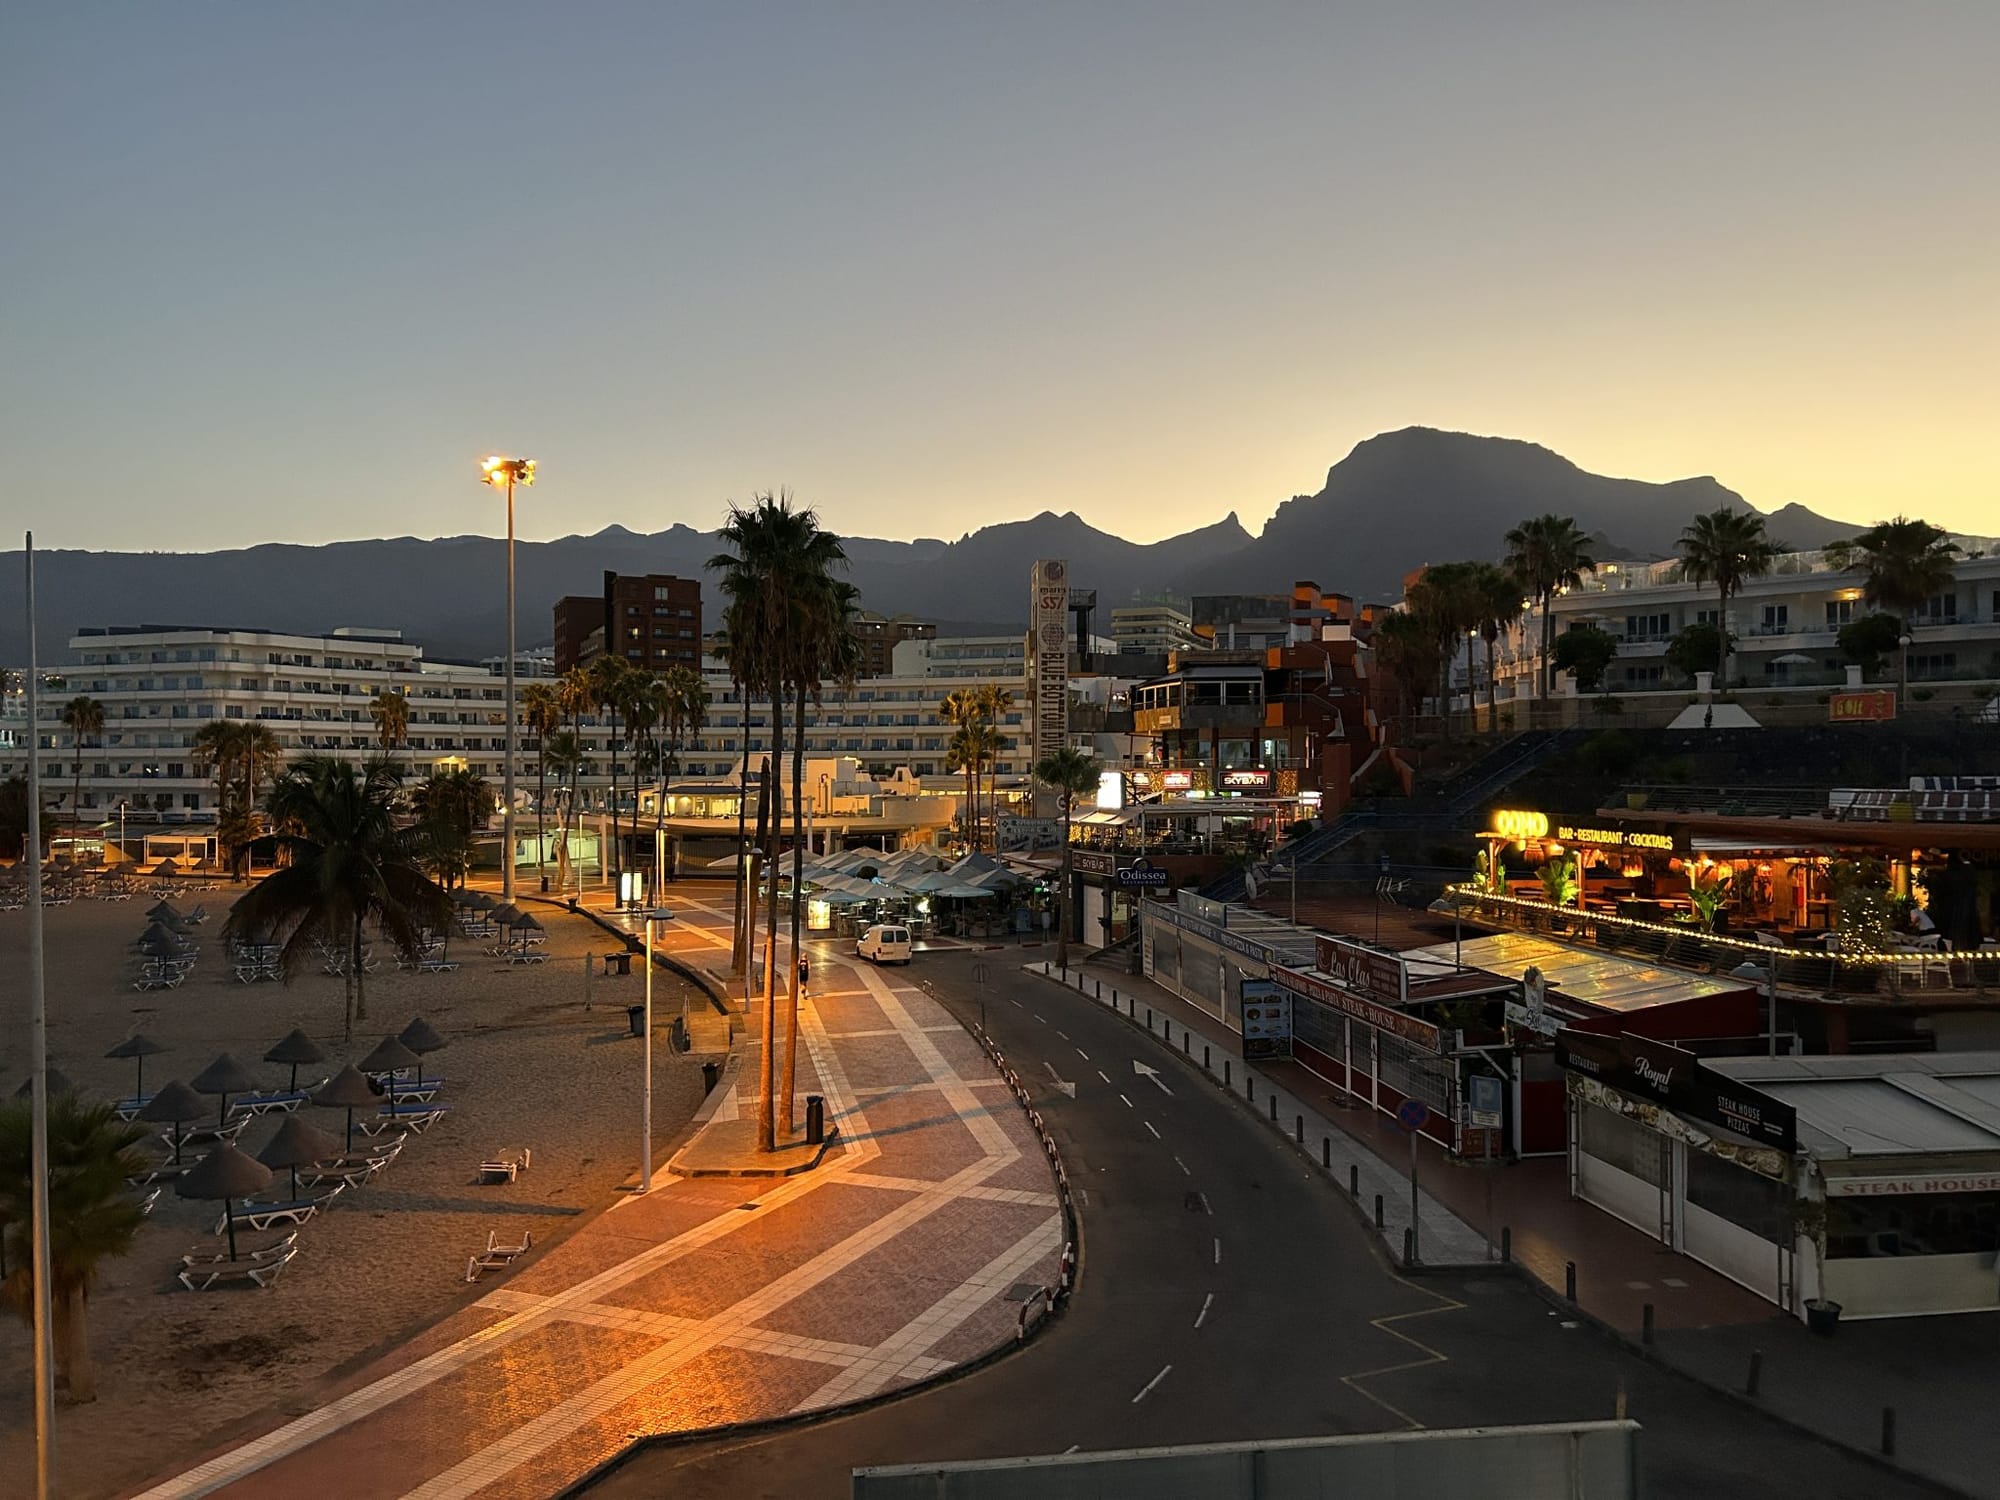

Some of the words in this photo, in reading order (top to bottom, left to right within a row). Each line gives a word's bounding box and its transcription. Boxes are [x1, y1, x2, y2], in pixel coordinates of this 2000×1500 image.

[1041, 653, 1065, 680] BLUE
[1041, 684, 1065, 730] BOTTOM
[1224, 775, 1265, 786] SKYBAR
[1558, 826, 1574, 841] BAR
[1577, 828, 1623, 845] RESTAURANT
[1628, 833, 1673, 851] COCKTAILS
[1120, 870, 1166, 880] Odissea
[1330, 952, 1347, 977] Las
[1348, 957, 1371, 988] Olas
[1342, 996, 1366, 1018] STEAK
[1369, 1007, 1395, 1030] HOUSE
[1569, 1052, 1600, 1074] RESTAURANT
[1634, 1056, 1675, 1088] Royal
[1718, 1095, 1737, 1112] STEAK
[1739, 1104, 1761, 1121] HOUSE
[1727, 1116, 1750, 1135] PIZZAS
[1842, 1182, 1914, 1195] STEAK
[1924, 1178, 2000, 1192] HOUSE
